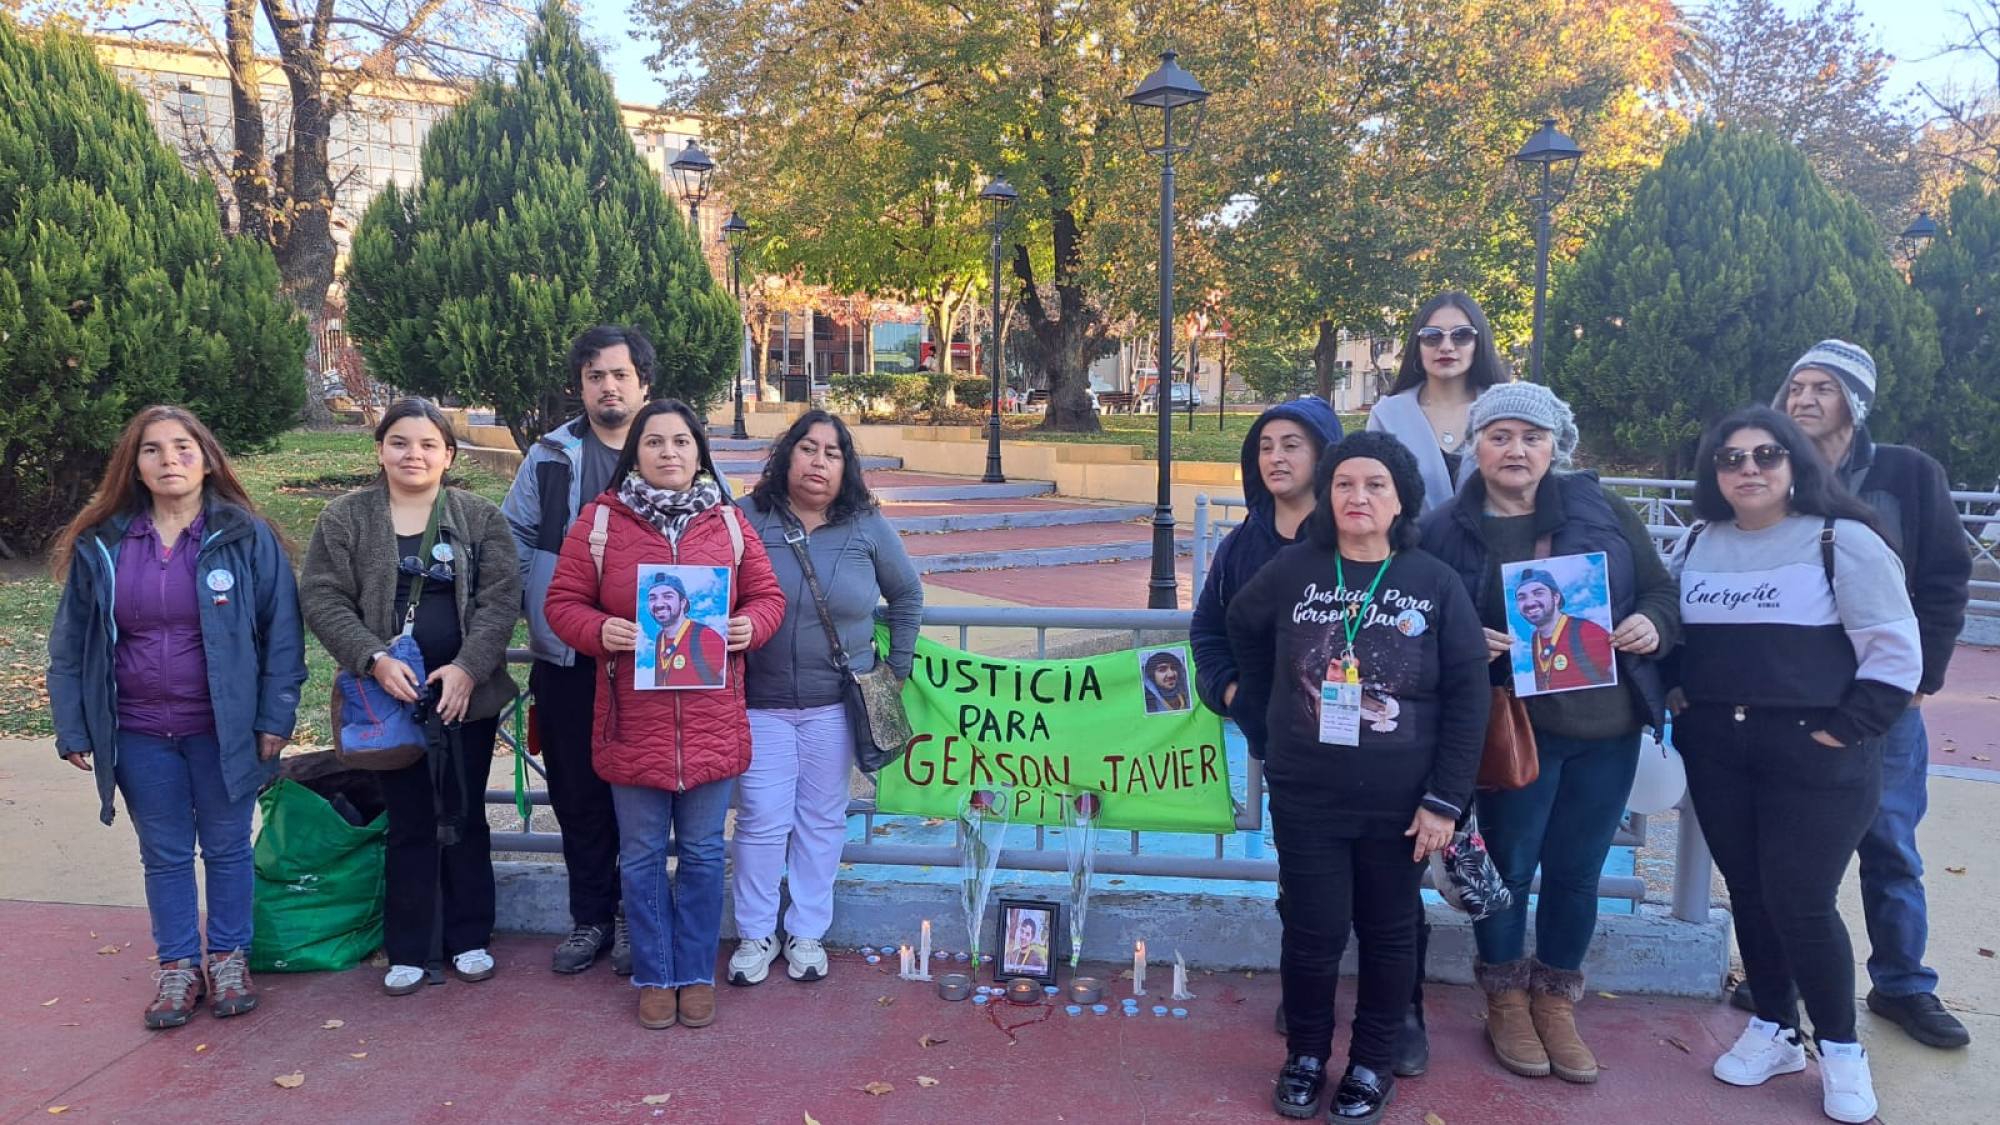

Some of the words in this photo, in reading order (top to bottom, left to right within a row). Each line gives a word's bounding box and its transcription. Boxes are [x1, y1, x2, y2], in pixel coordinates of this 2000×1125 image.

[1303, 583, 1375, 606] Justicia
[1383, 589, 1434, 612] Para
[1686, 580, 1780, 610] Energetic
[1292, 602, 1350, 624] Gerson
[960, 705, 1050, 743] PARA
[904, 734, 1070, 788] GERSON
[1100, 744, 1218, 793] JAVIER
[971, 790, 1090, 819] OPIT
